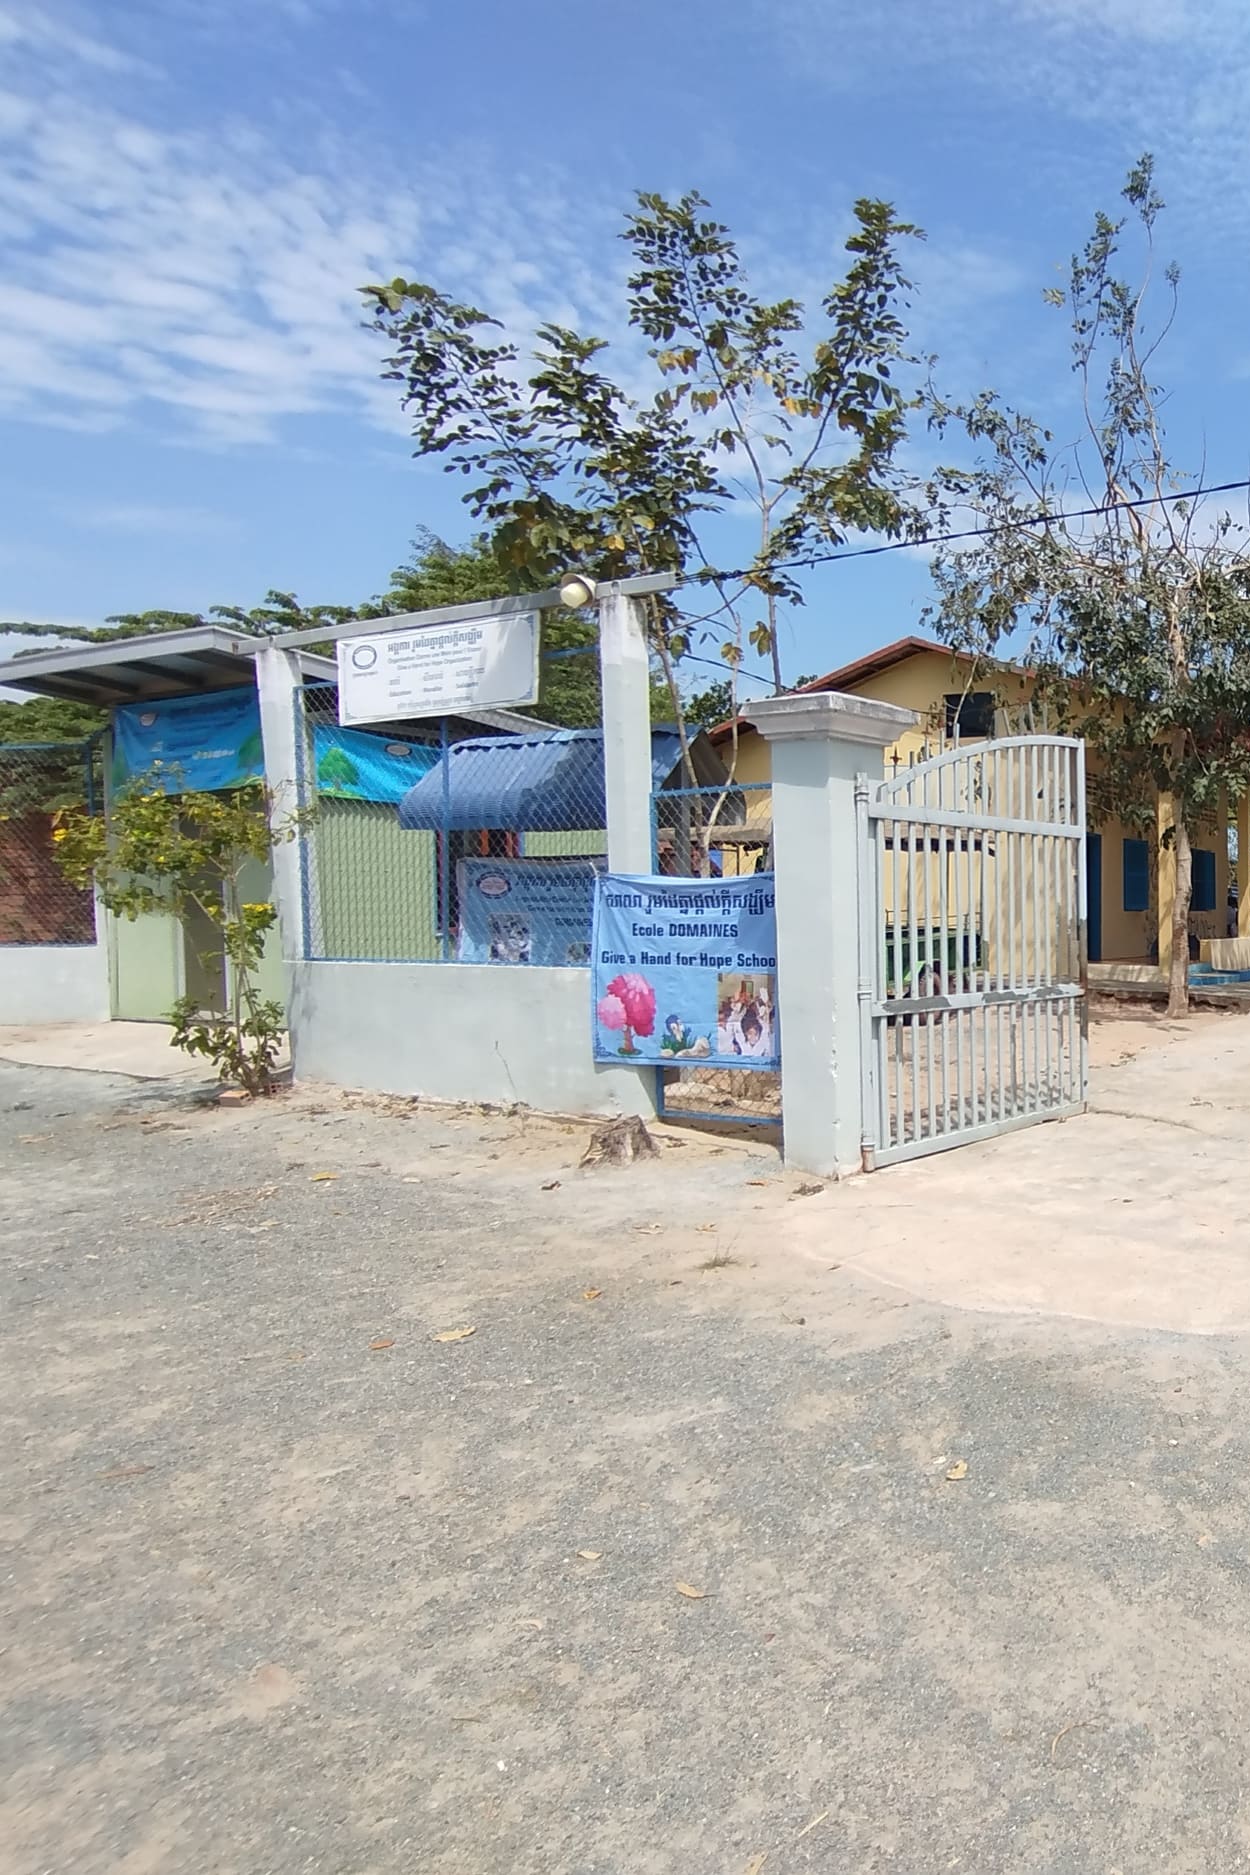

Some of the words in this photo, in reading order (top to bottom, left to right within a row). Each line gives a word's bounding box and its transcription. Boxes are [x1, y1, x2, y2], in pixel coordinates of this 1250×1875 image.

[632, 923, 664, 937] Ecole
[669, 923, 738, 938] DOMAINES
[602, 950, 626, 964] Give
[629, 953, 636, 964] a
[641, 951, 671, 965] Hand
[676, 952, 698, 966] for
[701, 953, 733, 970] Hope
